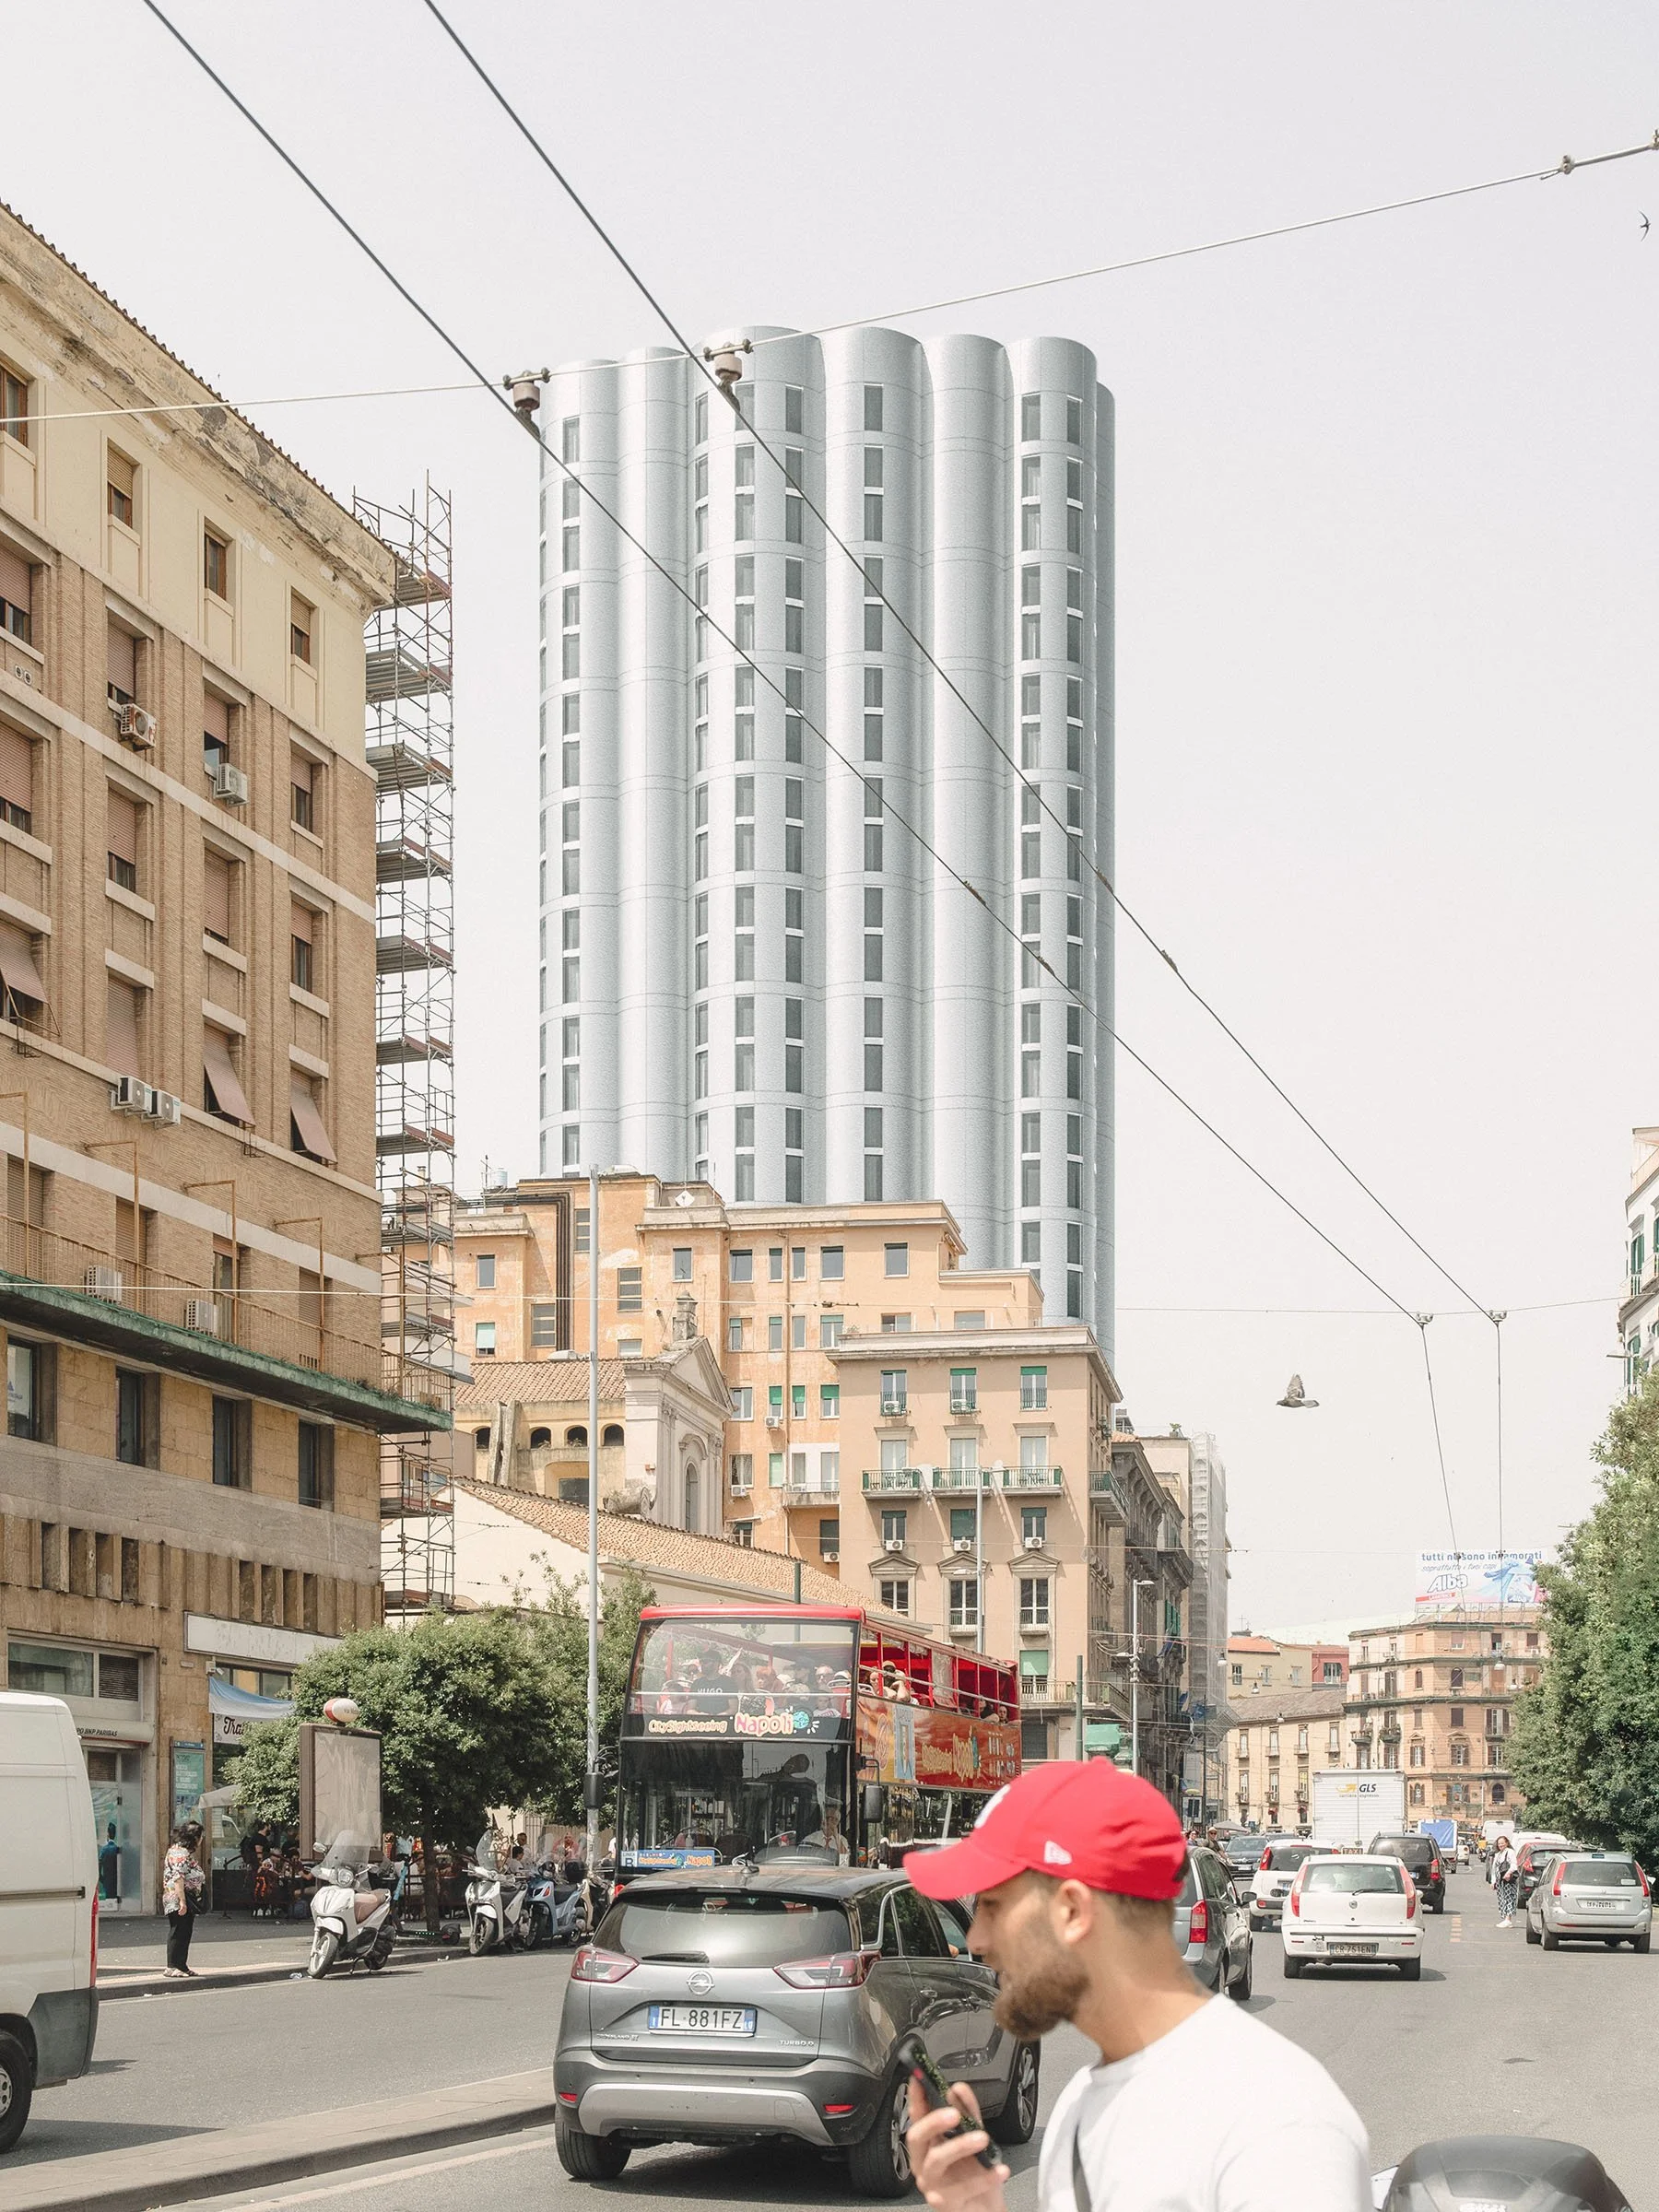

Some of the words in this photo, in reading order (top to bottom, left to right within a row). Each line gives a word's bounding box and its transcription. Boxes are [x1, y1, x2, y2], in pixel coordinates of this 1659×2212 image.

[1421, 1552, 1444, 1561] tutti
[1427, 1573, 1468, 1593] Alba
[735, 1712, 794, 1736] Napoli
[1359, 1783, 1376, 1793] GLS
[661, 2009, 680, 2027] FL
[688, 2009, 743, 2029] 881FZ
